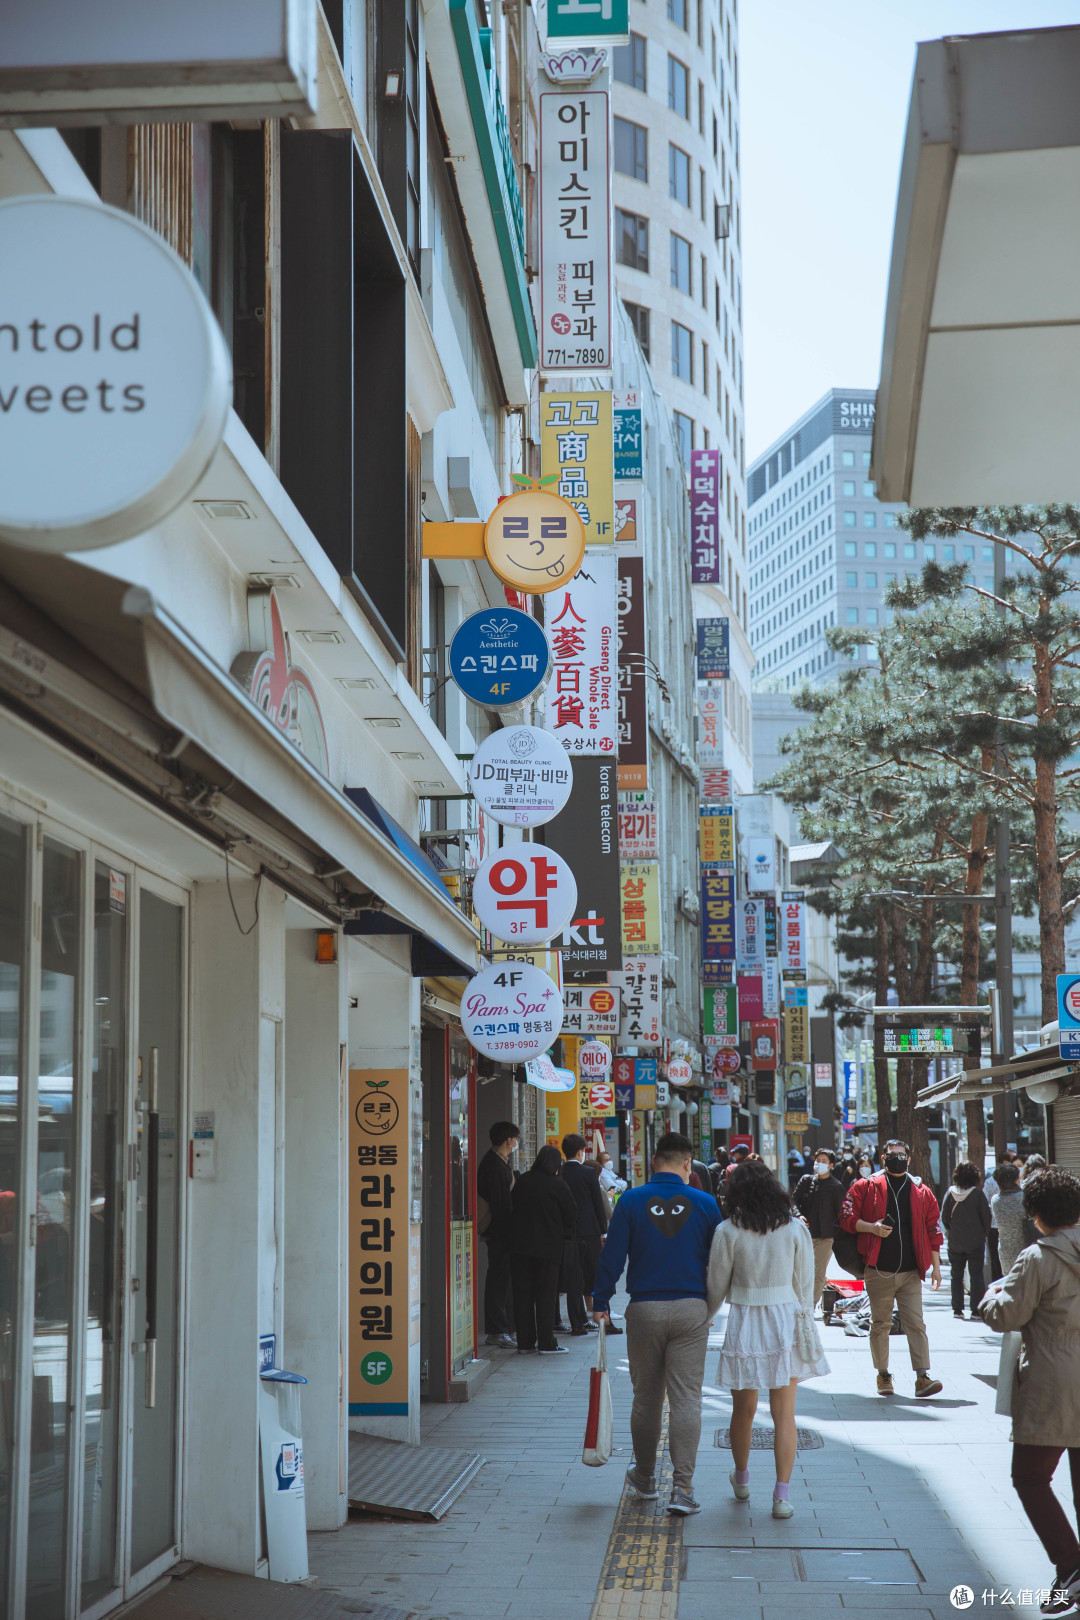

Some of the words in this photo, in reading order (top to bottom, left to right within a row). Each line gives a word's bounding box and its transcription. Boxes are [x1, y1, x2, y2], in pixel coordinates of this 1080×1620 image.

[558, 100, 591, 240] 아미스킨
[572, 260, 597, 341] 피부과
[552, 315, 570, 333] 5F
[547, 349, 604, 365] 771-7890
[545, 400, 599, 426] 고고
[840, 417, 875, 428] DUT
[614, 467, 641, 477] -1482
[596, 522, 610, 535] 1F
[694, 477, 717, 569] 덕수치과
[700, 573, 712, 581] 2F
[479, 639, 519, 648] Aesthetic
[601, 626, 612, 672] Ginseng
[699, 647, 728, 658] 수선
[460, 654, 539, 673] 스킨스파
[489, 683, 511, 695] 4F
[589, 666, 600, 703] Whole
[601, 676, 612, 710] Direct
[589, 705, 600, 730] Sale
[556, 738, 597, 750] 승상사
[600, 739, 613, 750] 2F
[503, 783, 537, 796] 클리닉
[599, 766, 612, 800] korea
[702, 770, 730, 797] 공증
[514, 812, 529, 823] F6
[601, 804, 613, 854] telecom
[489, 857, 557, 928] 약
[622, 878, 647, 942] 상품권
[706, 878, 733, 943] 전당포
[510, 921, 528, 934] 3F
[562, 910, 605, 946] kt
[786, 904, 800, 955] 상품권
[562, 950, 607, 960] 공식대리점
[625, 963, 646, 972] 소공
[493, 971, 523, 987] 4F
[650, 974, 658, 1002] 바지락
[467, 993, 509, 1018] Pams
[513, 993, 546, 1018] Spa
[593, 993, 612, 1010] 금
[625, 975, 646, 1040] 칼국수
[586, 1014, 617, 1022] 고가매입
[713, 989, 728, 1034] 상품권
[473, 1022, 520, 1037] 스킨스파
[523, 1020, 552, 1034] 명동점
[1069, 1032, 1080, 1041] K
[705, 1036, 737, 1046] 776-7700
[582, 1052, 607, 1066] 헤어
[638, 1063, 655, 1080] 元
[580, 1085, 589, 1109] 수선
[591, 1085, 612, 1107] 옷
[637, 1090, 656, 1106] HKD
[358, 1145, 398, 1166] 명동
[359, 1174, 395, 1341] 라라의원
[367, 1361, 387, 1376] 5F
